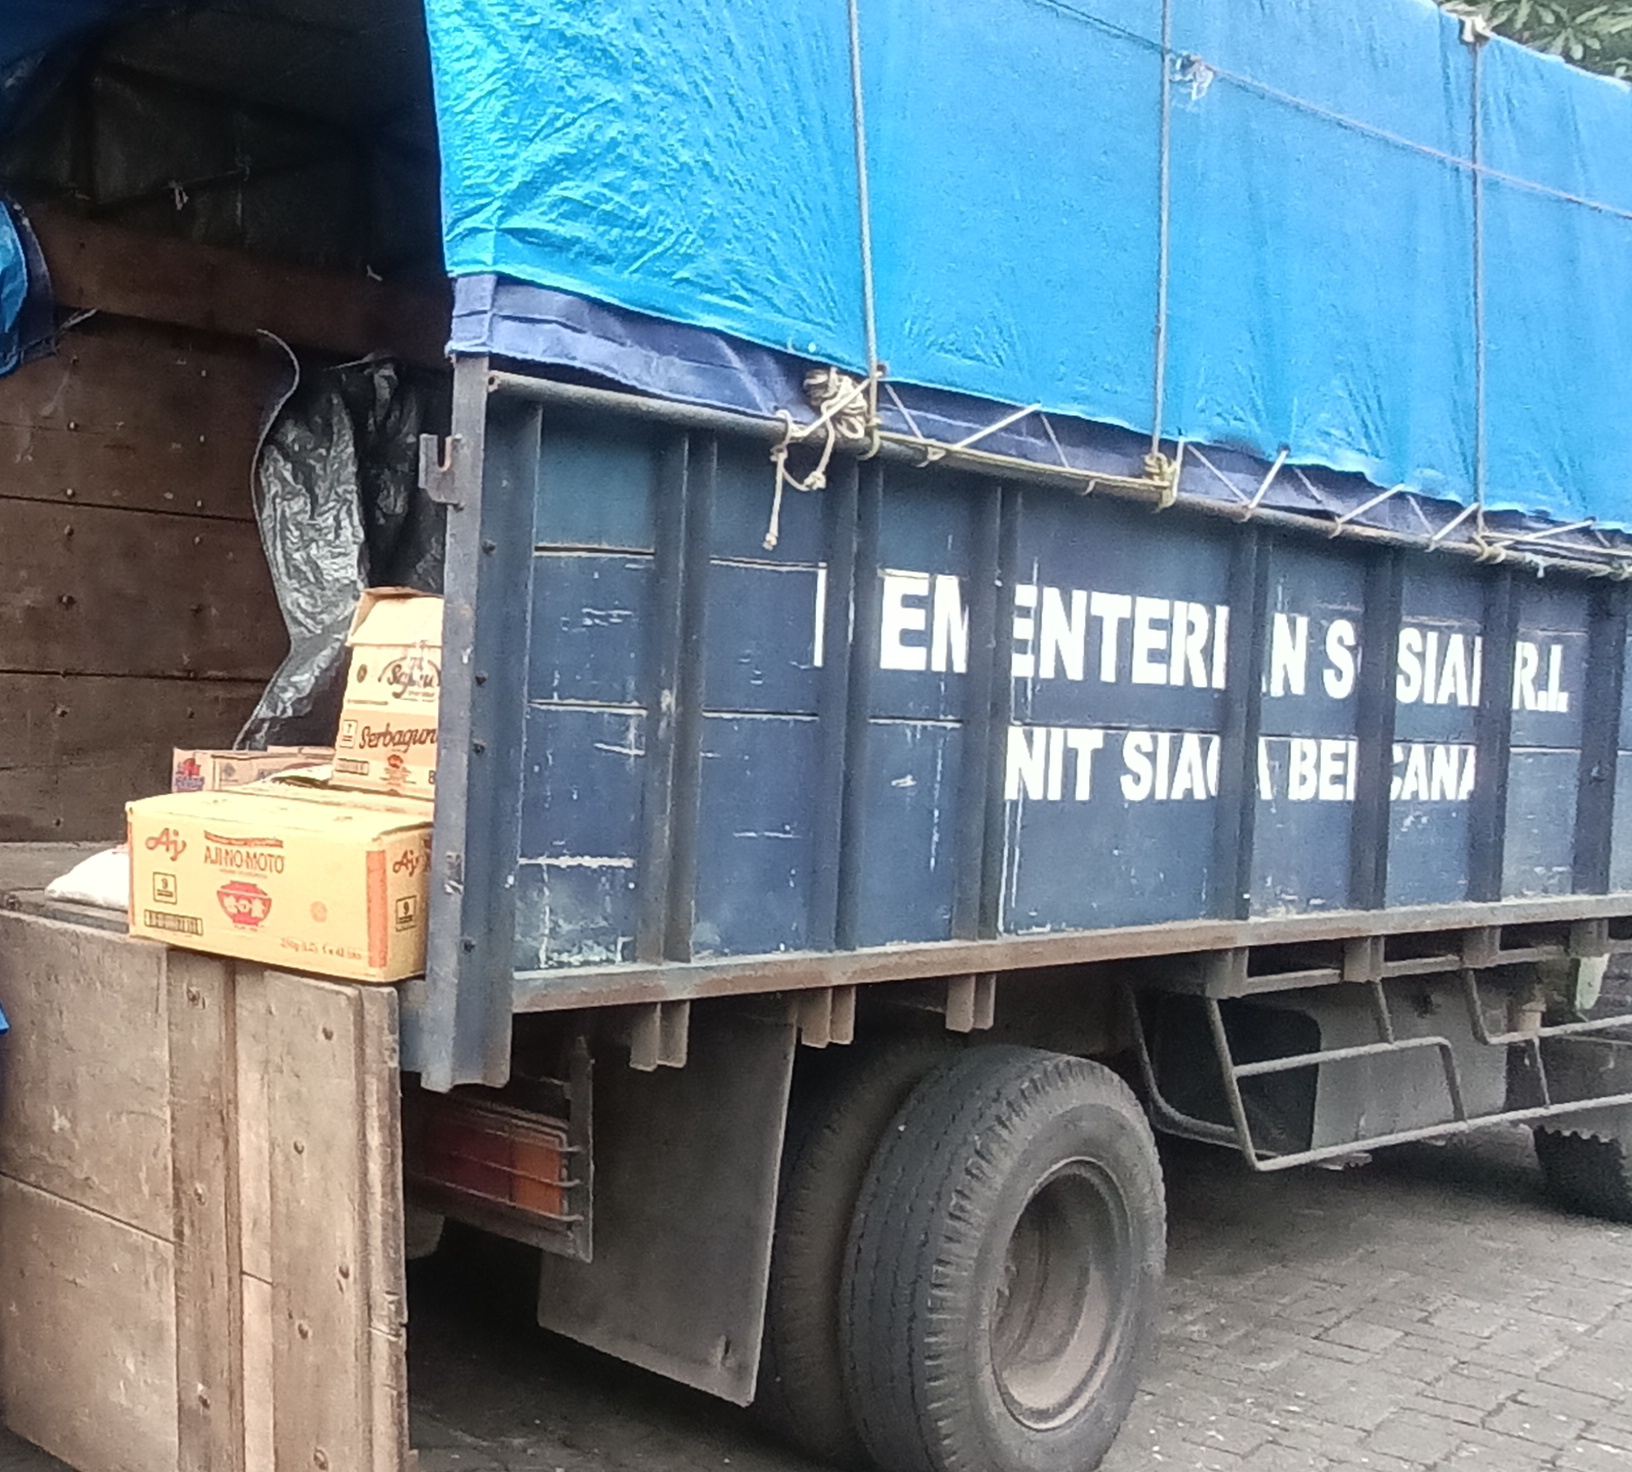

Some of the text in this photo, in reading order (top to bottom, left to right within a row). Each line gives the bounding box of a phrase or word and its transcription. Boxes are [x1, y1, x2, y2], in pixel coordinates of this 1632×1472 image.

[812, 562, 1310, 699] EMENTERIN
[1321, 618, 1483, 708] SSIA
[358, 721, 437, 754] Serbagun
[1004, 725, 1105, 802] NIT
